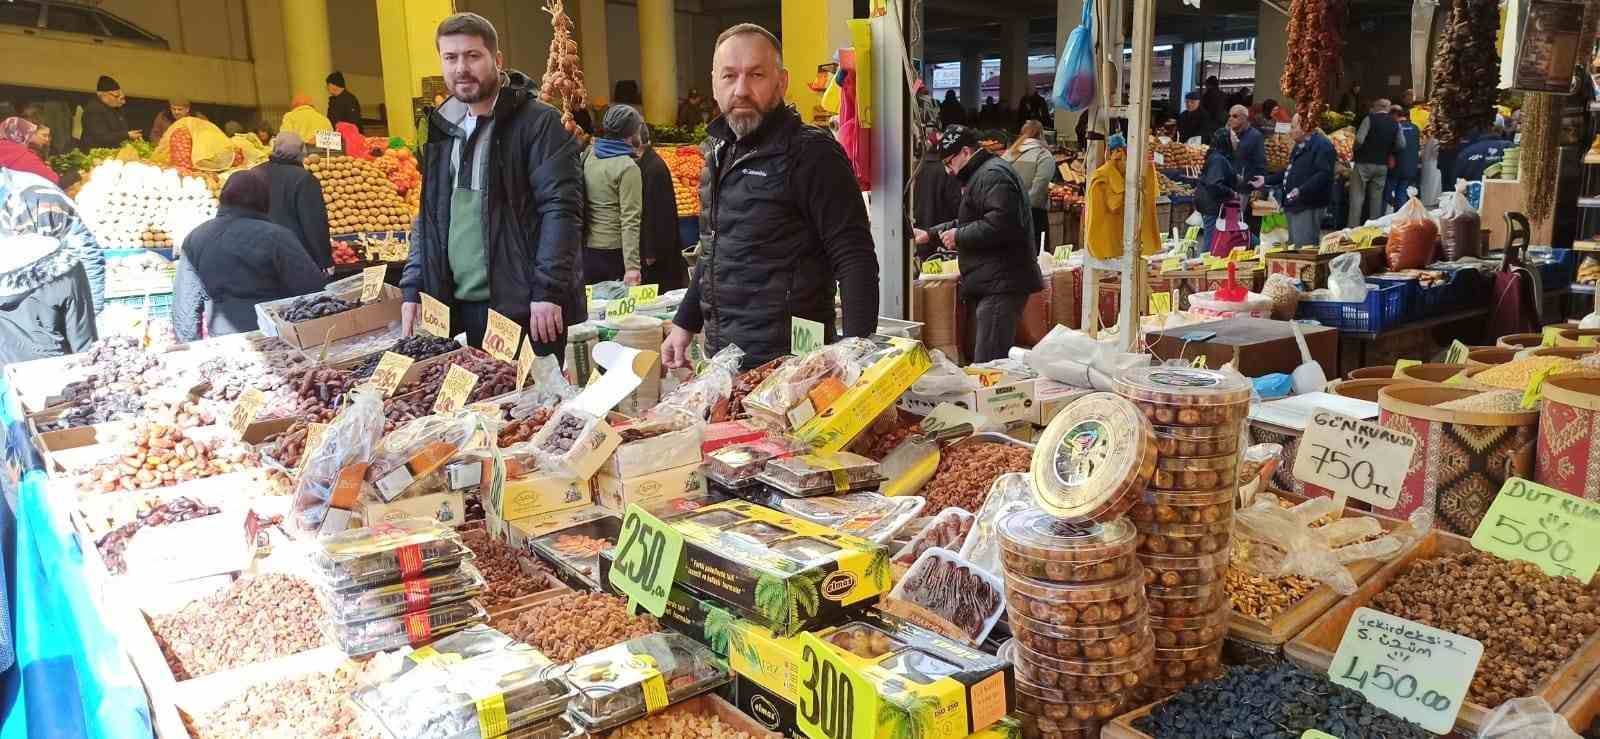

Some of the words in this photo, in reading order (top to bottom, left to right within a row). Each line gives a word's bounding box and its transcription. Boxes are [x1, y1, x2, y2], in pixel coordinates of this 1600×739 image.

[1503, 481, 1556, 506] DUT
[1491, 514, 1575, 562] 500
[799, 644, 854, 739] 300
